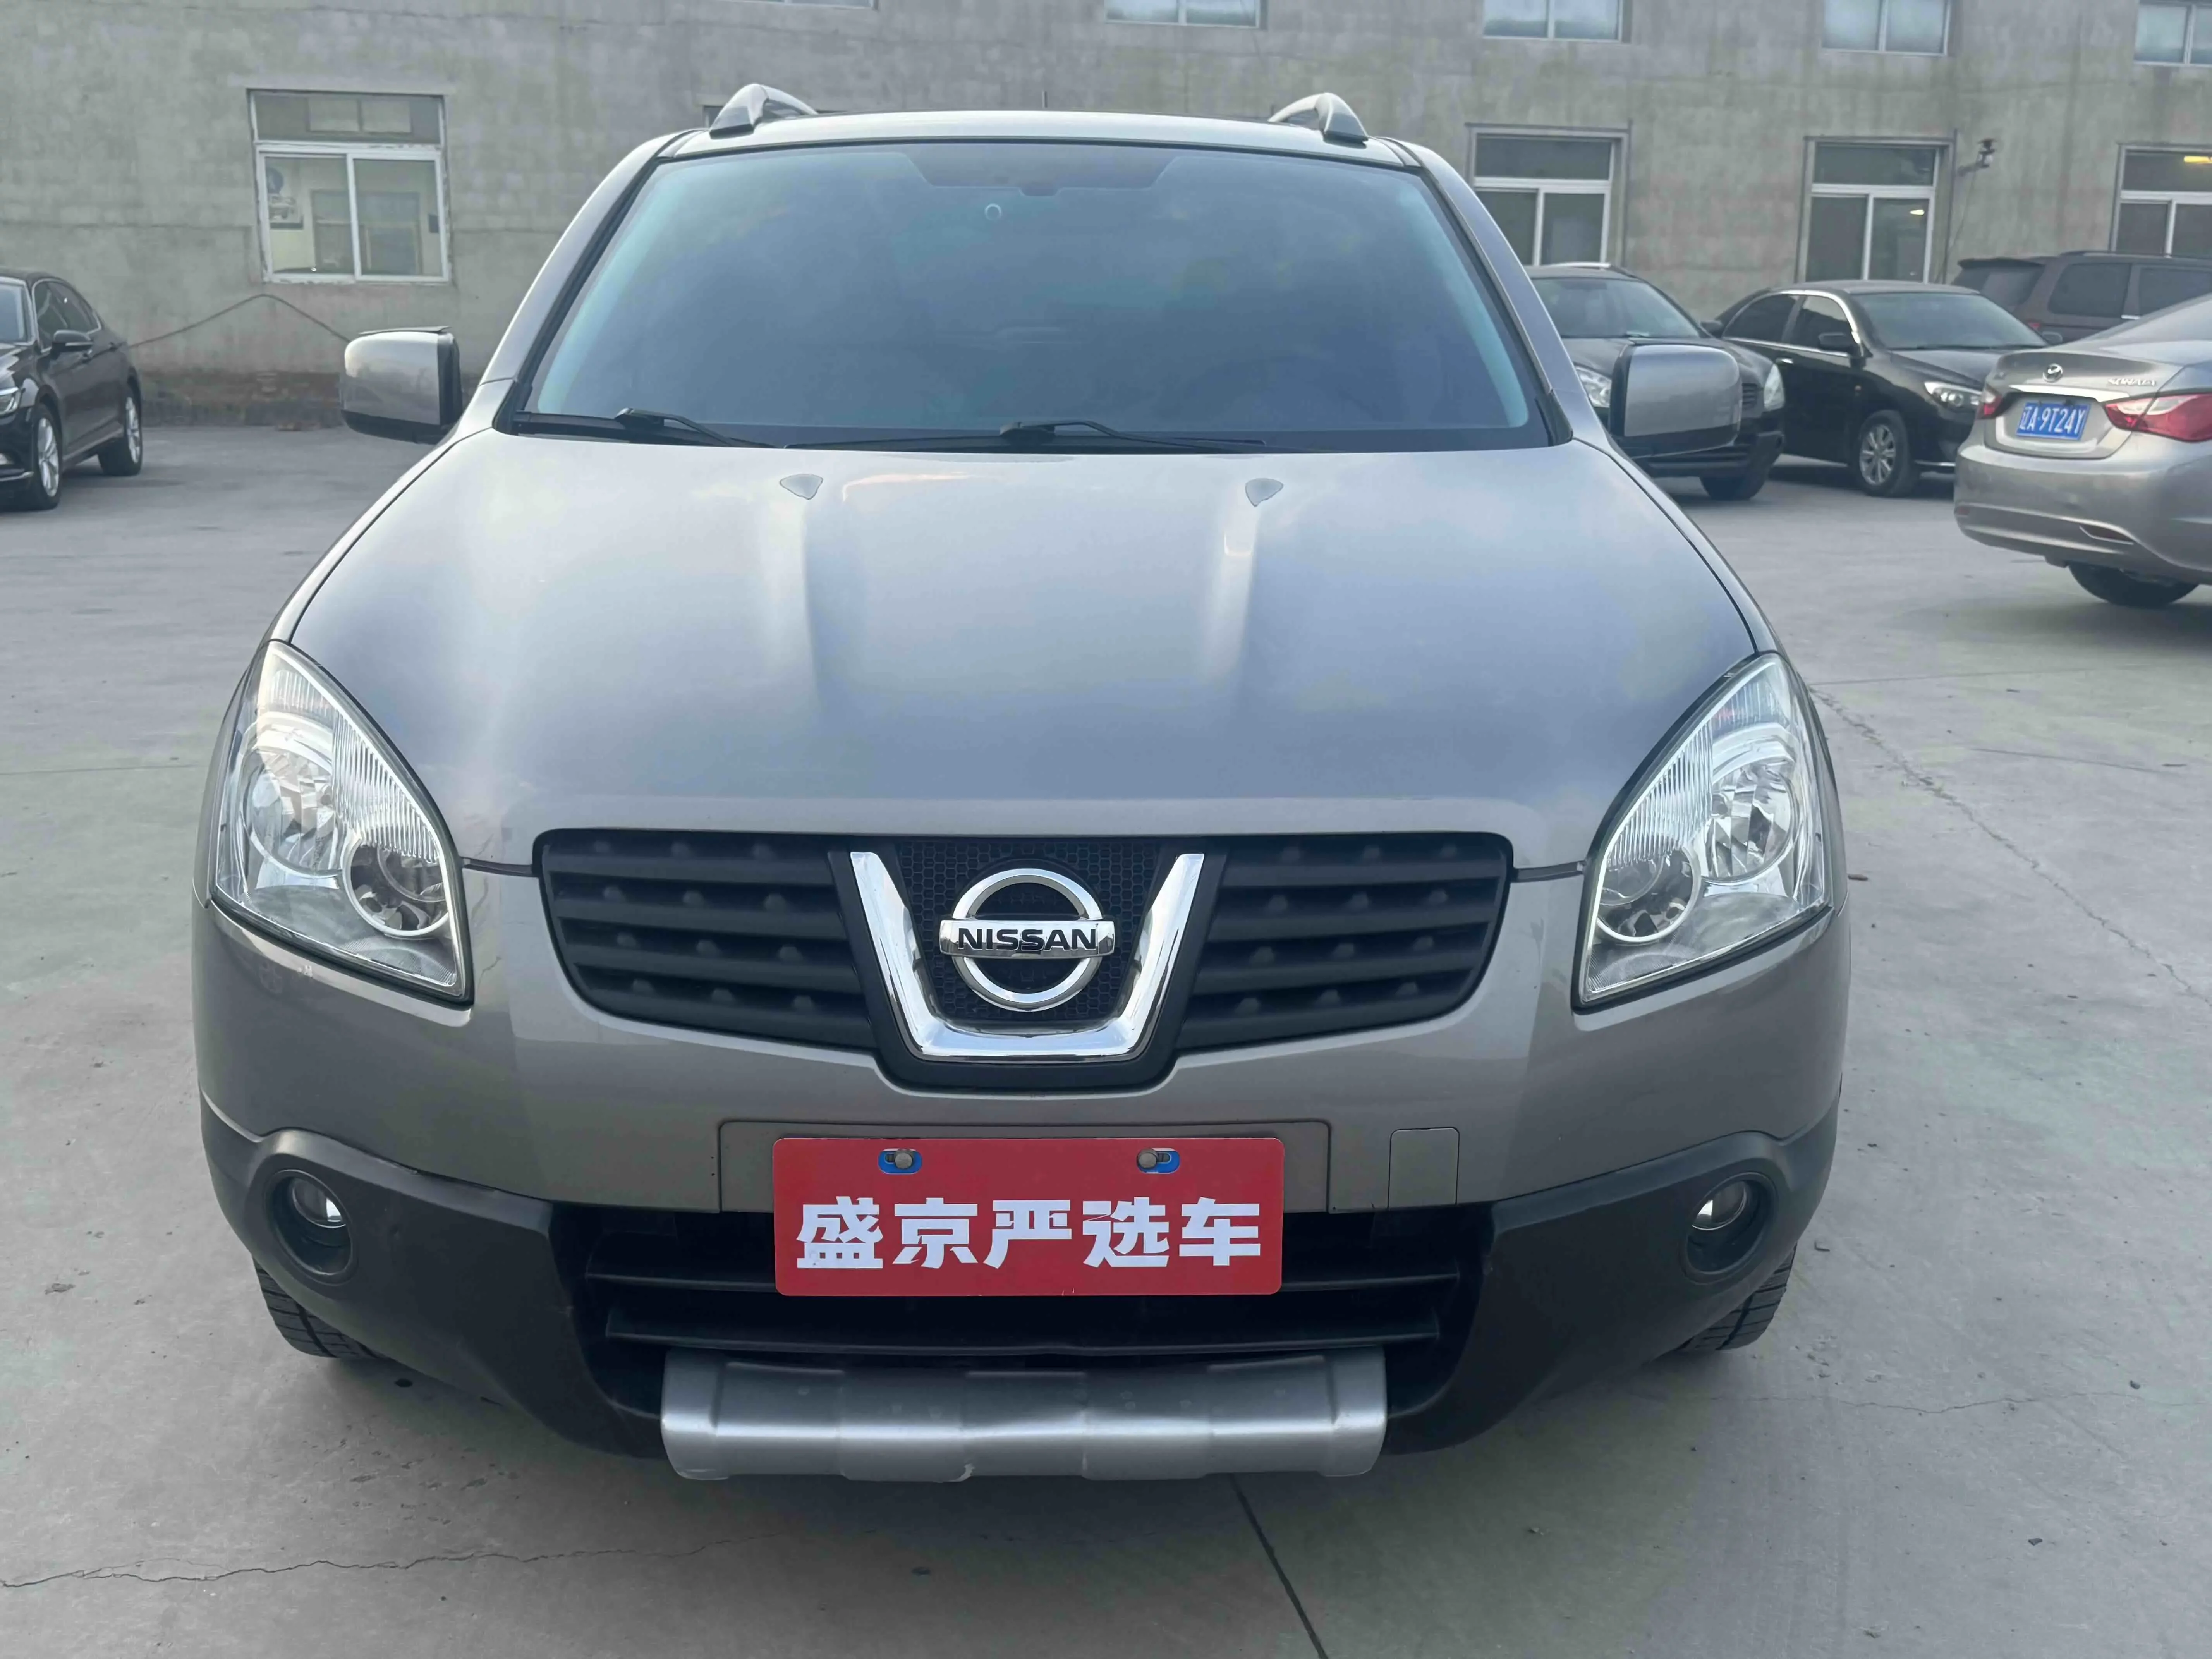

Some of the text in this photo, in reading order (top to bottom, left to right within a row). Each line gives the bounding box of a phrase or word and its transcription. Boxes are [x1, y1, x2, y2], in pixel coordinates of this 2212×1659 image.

[958, 928, 1096, 951] NISSAN
[796, 1196, 1261, 1269] 盛京严选车
